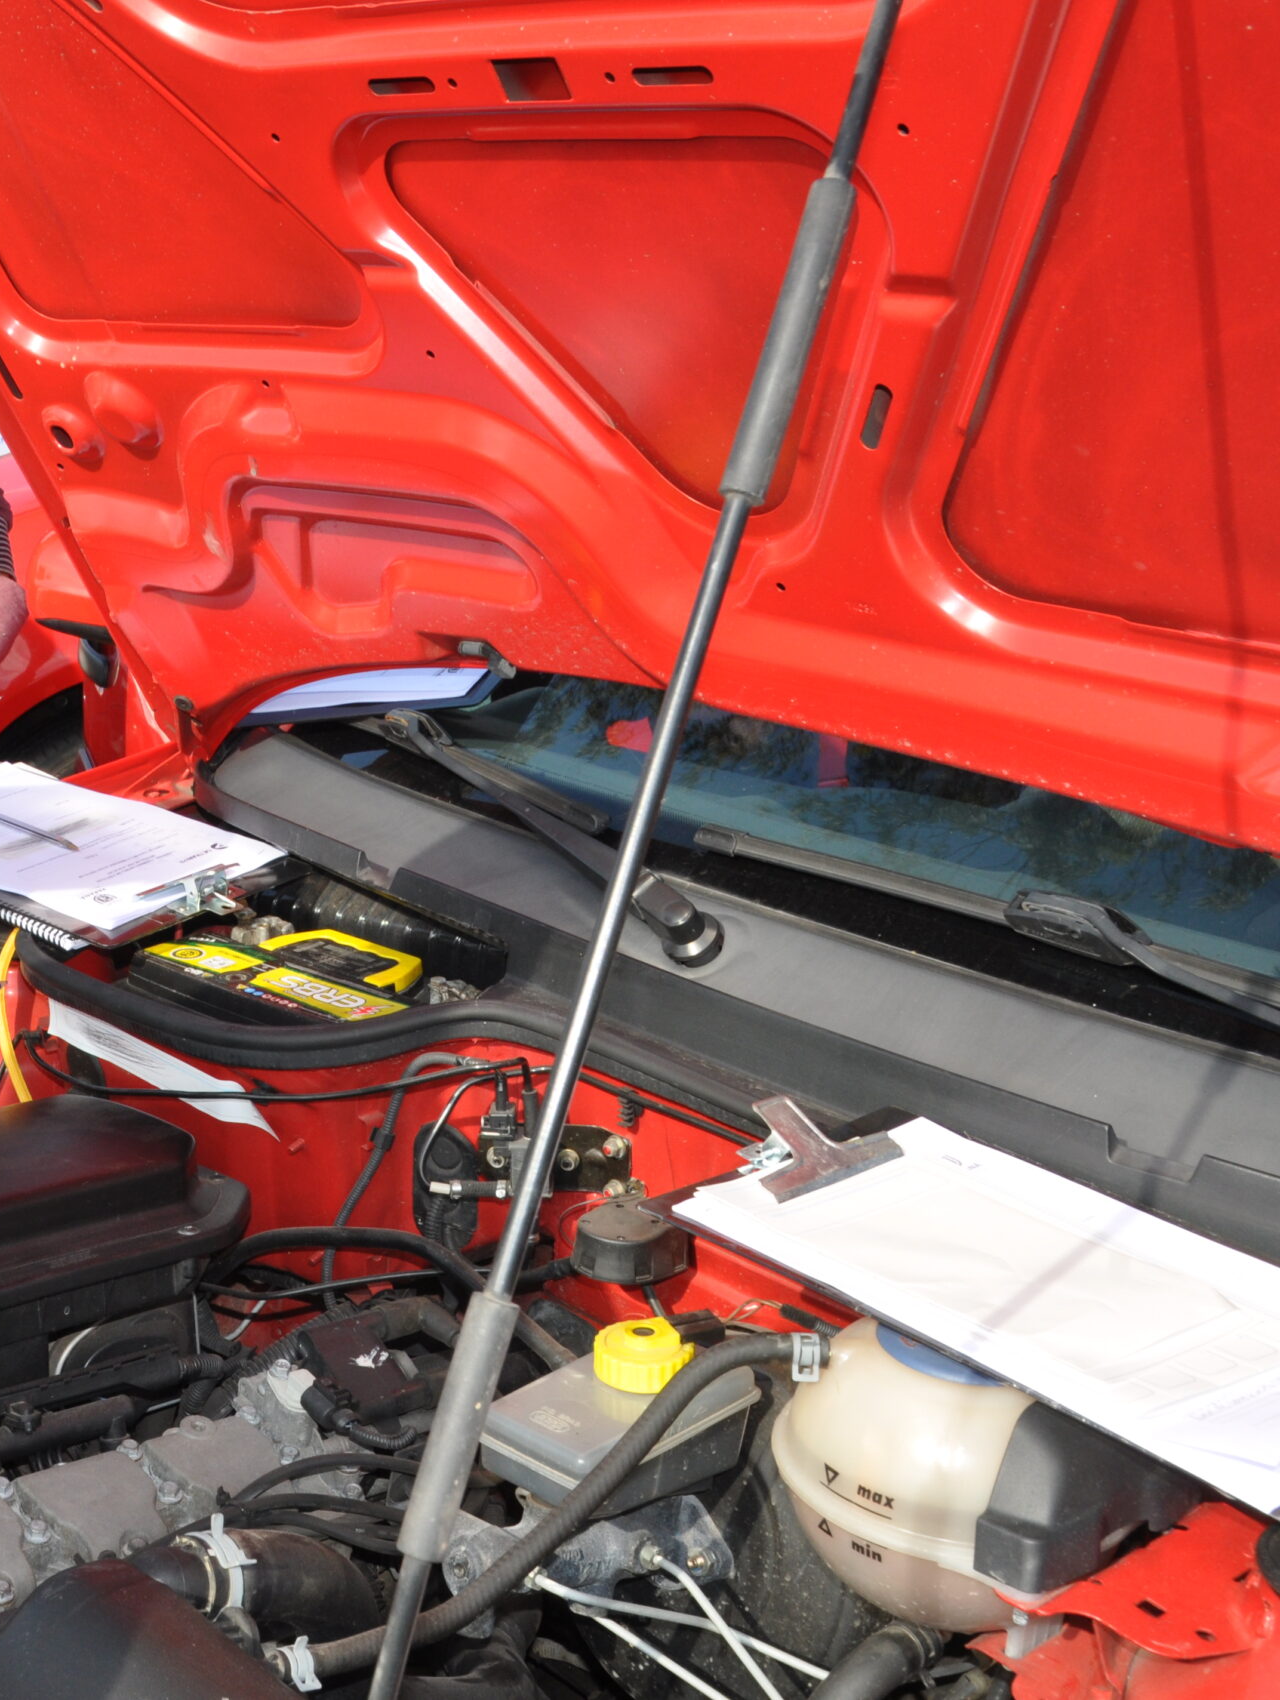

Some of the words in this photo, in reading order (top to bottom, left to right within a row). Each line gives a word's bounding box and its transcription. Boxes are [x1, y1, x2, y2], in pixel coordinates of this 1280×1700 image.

[270, 975, 366, 1008] ERBS
[856, 1484, 895, 1510] max
[851, 1540, 883, 1563] min
